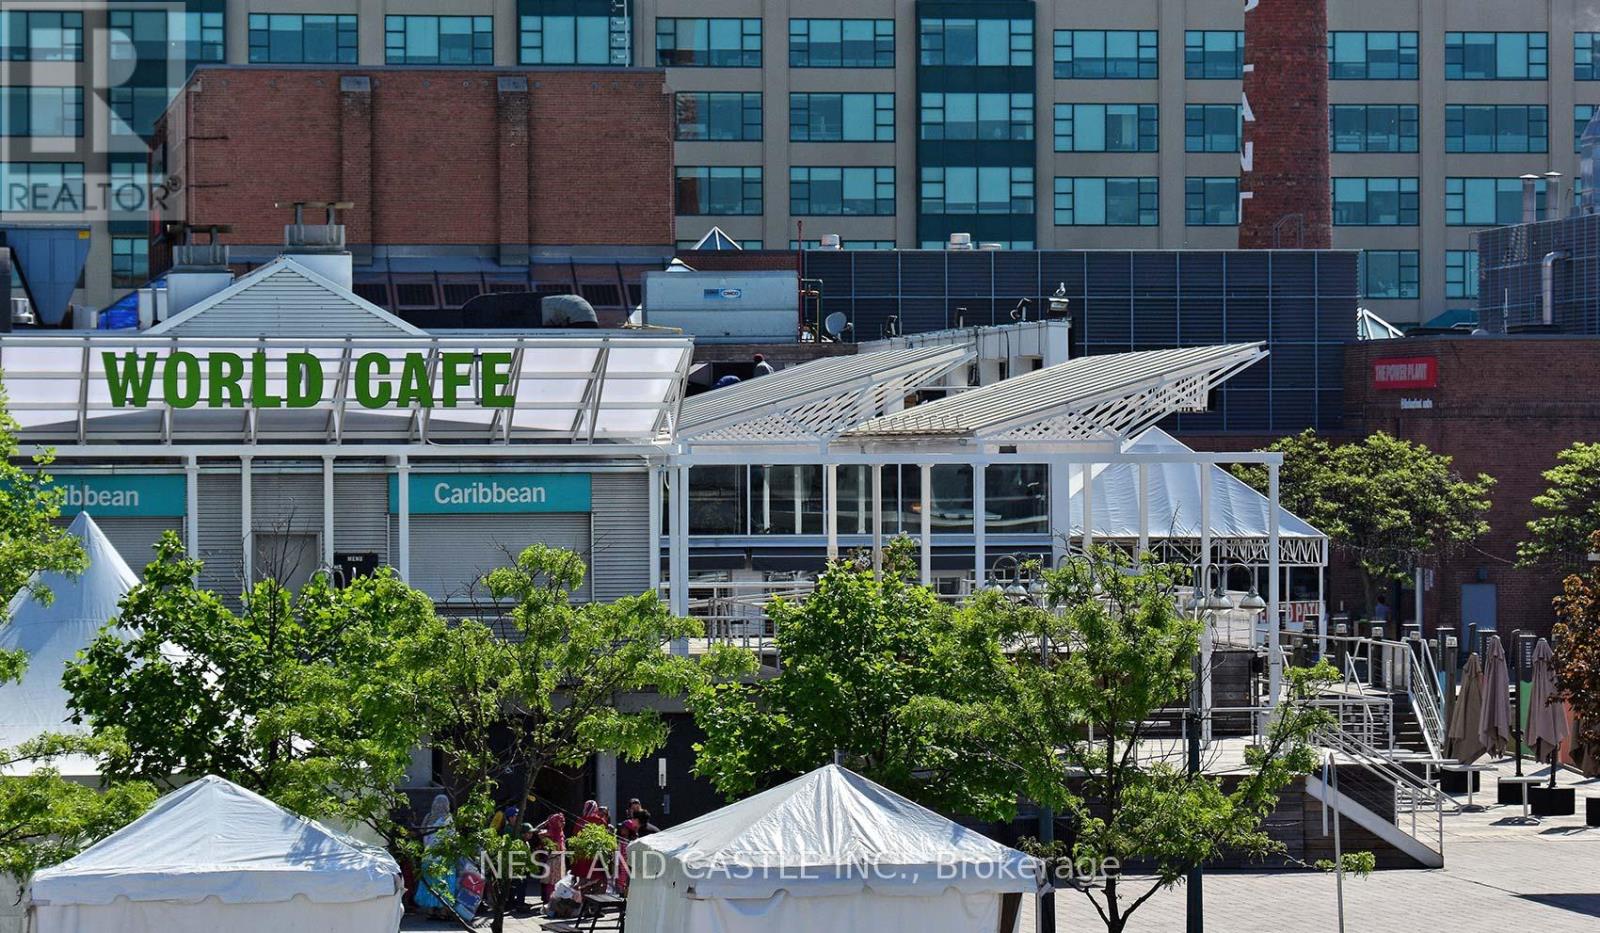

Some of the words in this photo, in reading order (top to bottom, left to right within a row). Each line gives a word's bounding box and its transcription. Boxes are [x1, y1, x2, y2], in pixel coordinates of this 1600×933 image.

[101, 351, 325, 409] WORLD
[354, 351, 516, 409] CAFE
[434, 482, 546, 504] Caribbean
